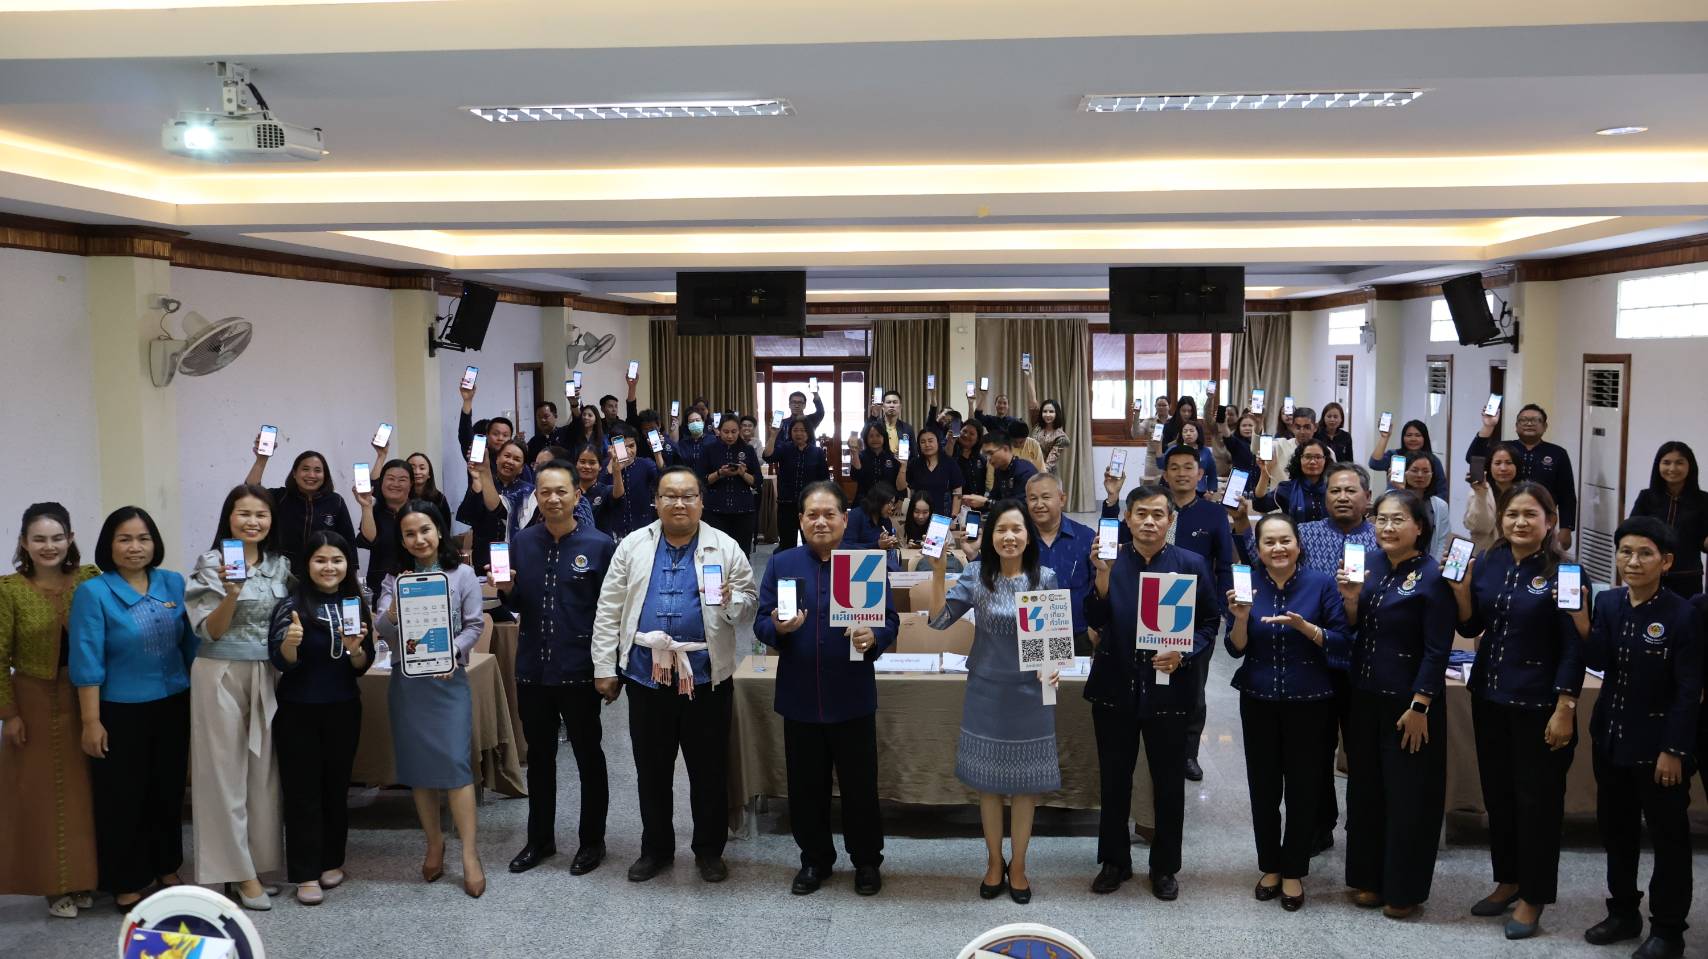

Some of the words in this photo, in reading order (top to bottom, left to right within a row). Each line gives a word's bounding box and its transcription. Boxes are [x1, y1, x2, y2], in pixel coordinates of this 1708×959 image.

[832, 610, 884, 624] คลิกชุมชน
[1138, 633, 1192, 648] คลิกชุมชน
